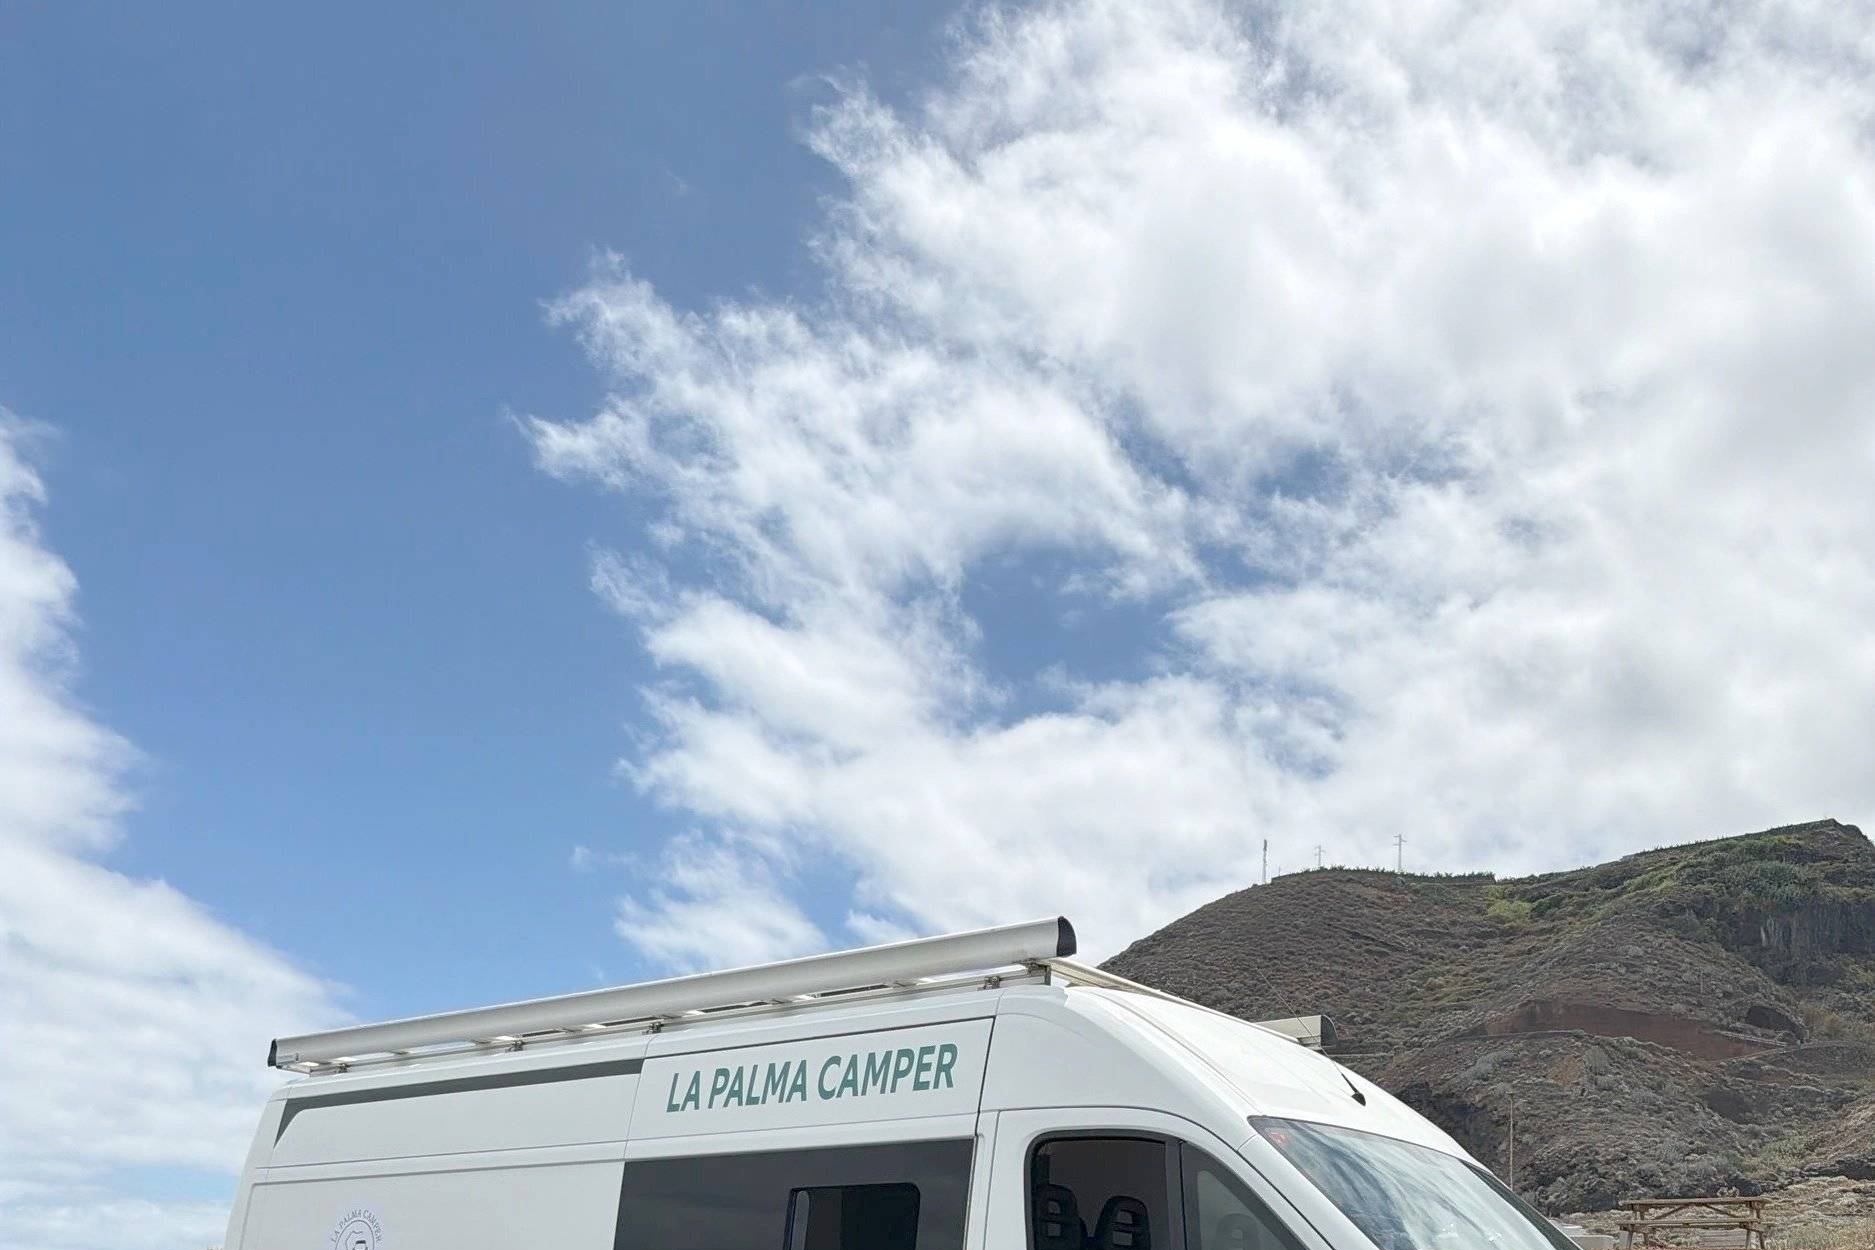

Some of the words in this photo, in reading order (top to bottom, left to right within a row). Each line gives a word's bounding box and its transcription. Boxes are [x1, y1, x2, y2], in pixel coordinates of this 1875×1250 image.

[666, 1070, 701, 1112] LA
[707, 1059, 807, 1109] PALMA
[817, 1043, 958, 1100] CAMPER
